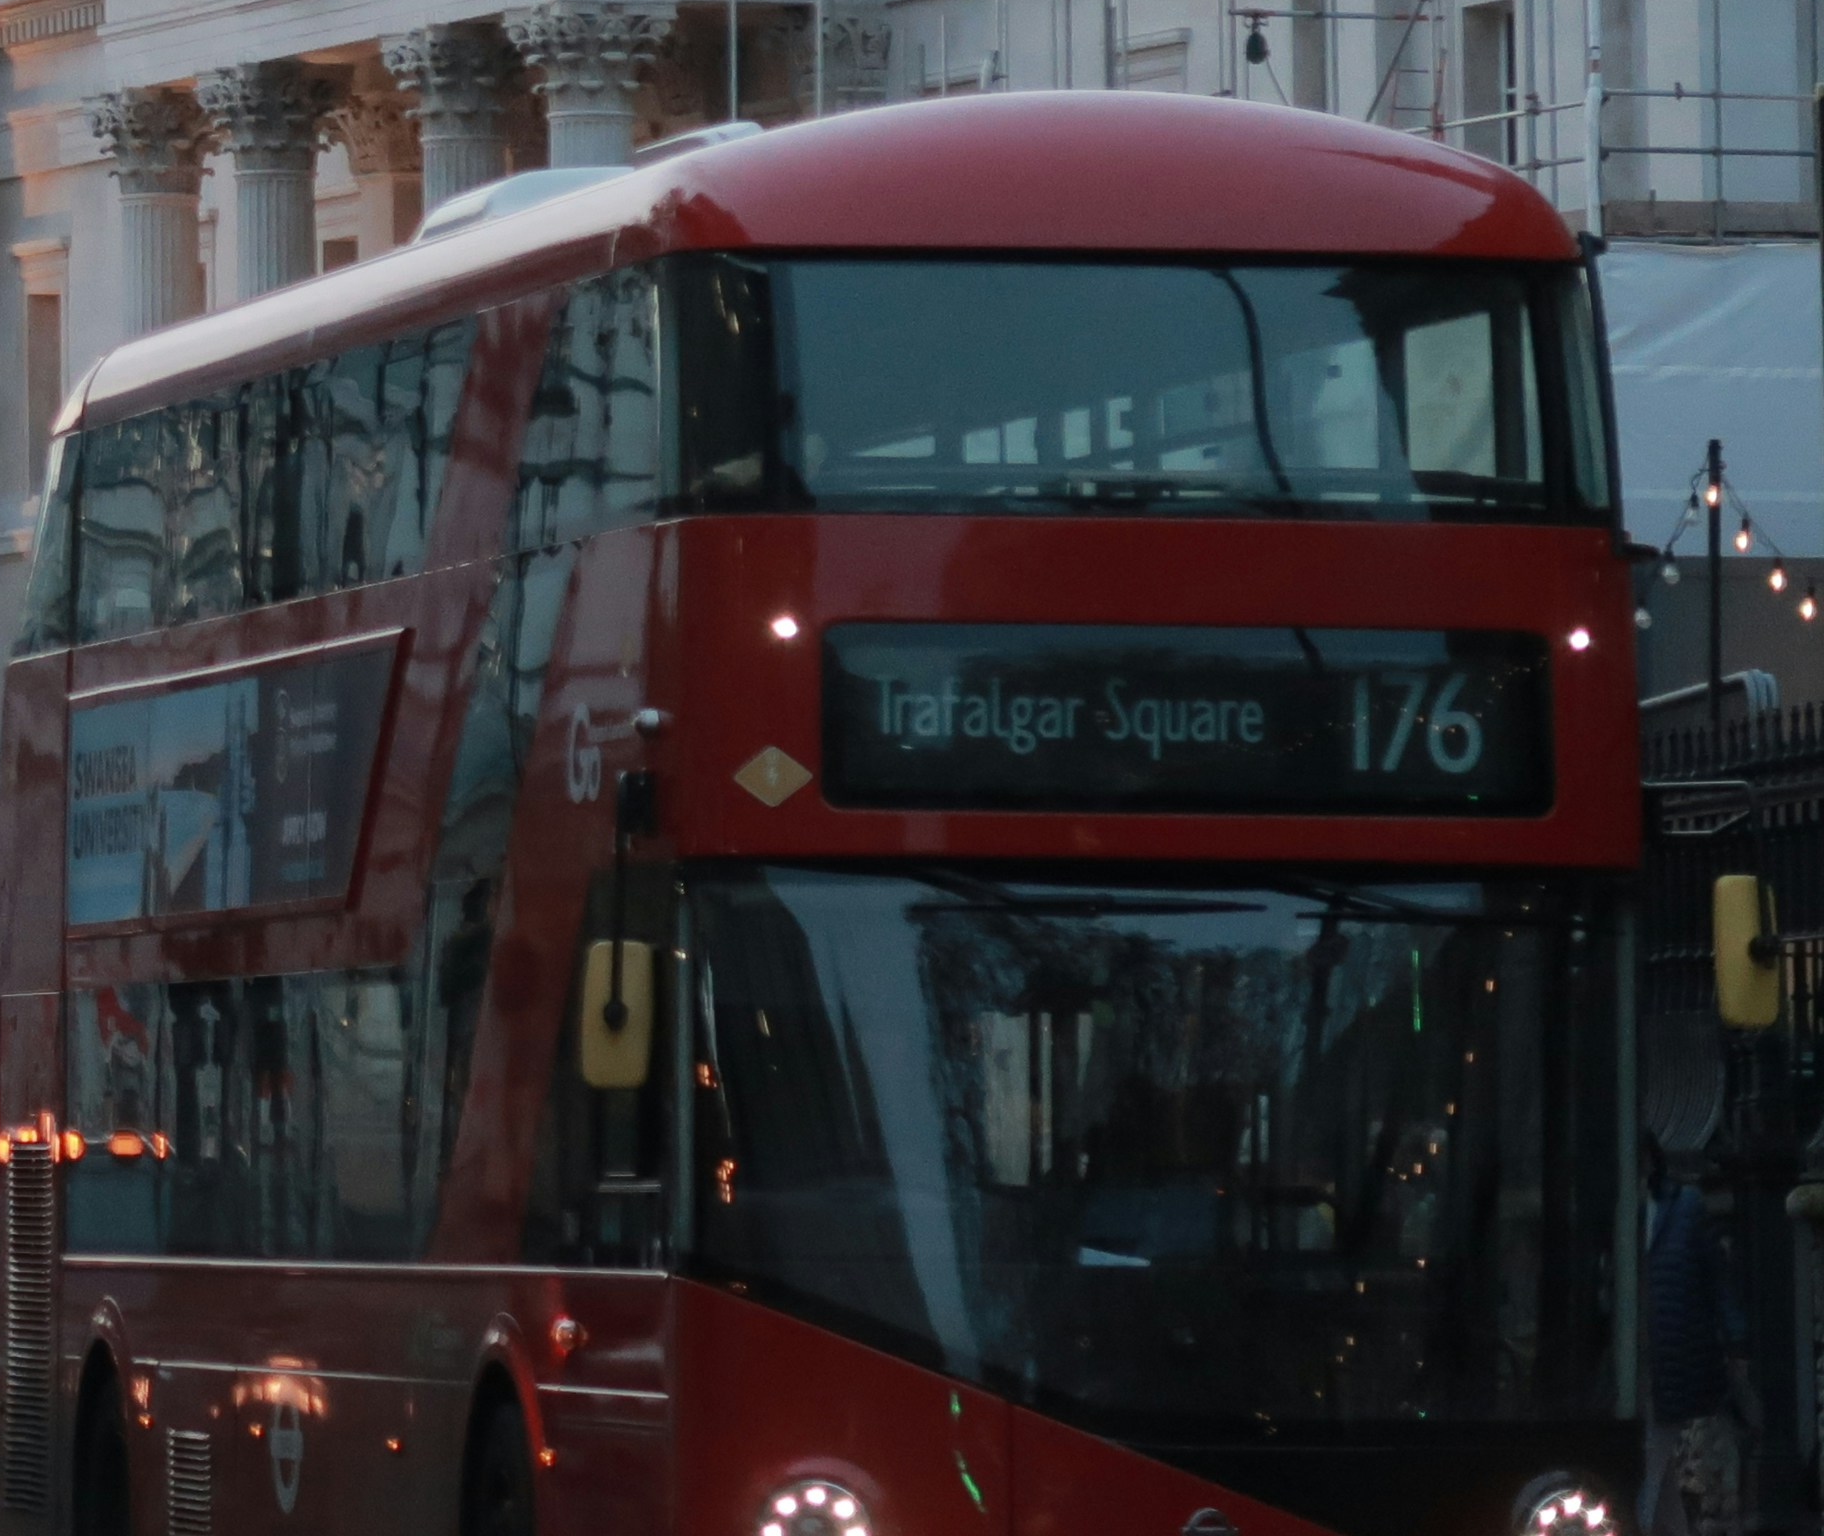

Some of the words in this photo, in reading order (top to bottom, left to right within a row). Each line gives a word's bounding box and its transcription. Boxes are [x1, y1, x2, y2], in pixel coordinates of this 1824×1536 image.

[877, 677, 1085, 755] Trafalgar
[1103, 677, 1265, 761] Square
[1354, 671, 1483, 774] 176
